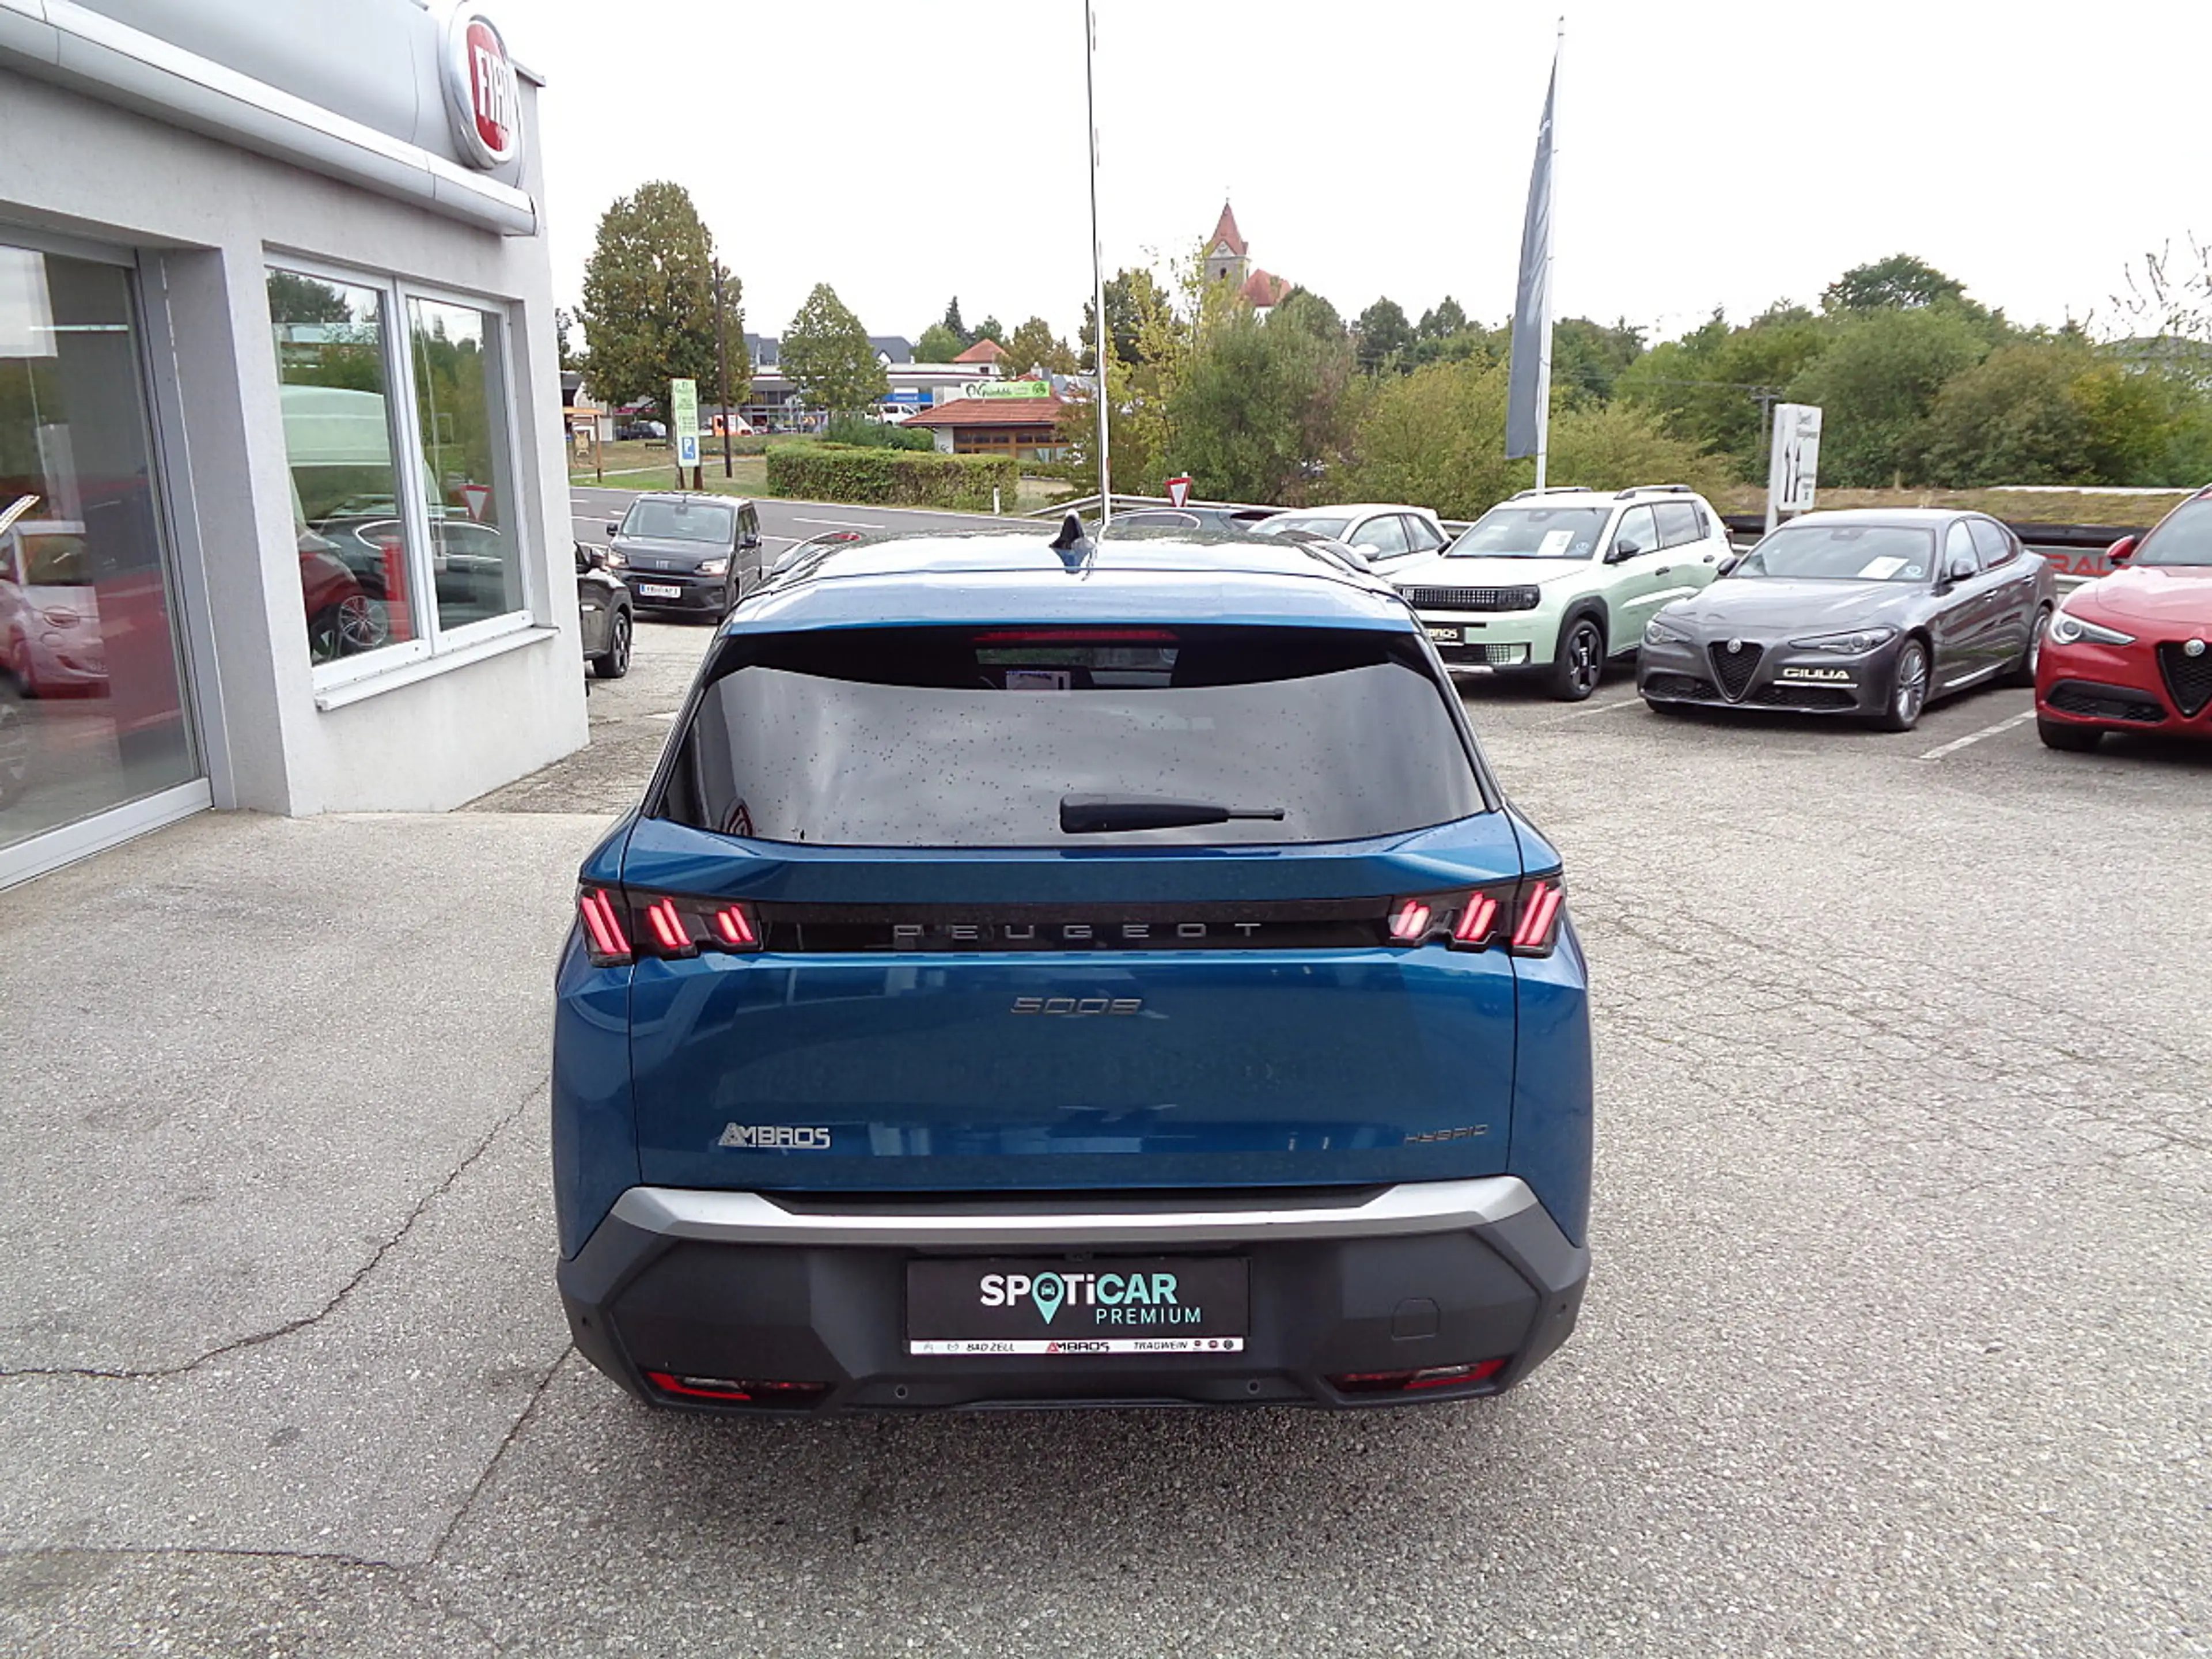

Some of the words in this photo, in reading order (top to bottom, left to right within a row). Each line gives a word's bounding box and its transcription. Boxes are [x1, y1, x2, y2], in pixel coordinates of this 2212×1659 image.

[1783, 667, 1850, 679] GIULIA
[893, 923, 1262, 940] PEUGEOT
[1010, 997, 1142, 1014] 5008
[718, 1122, 831, 1149] AMBROS
[1096, 1307, 1202, 1324] PREMIUM
[966, 1343, 988, 1351] BAD
[990, 1343, 1014, 1351] ZELL
[1046, 1342, 1110, 1353] AMBROS
[1133, 1341, 1188, 1350] TRAGWEIN
